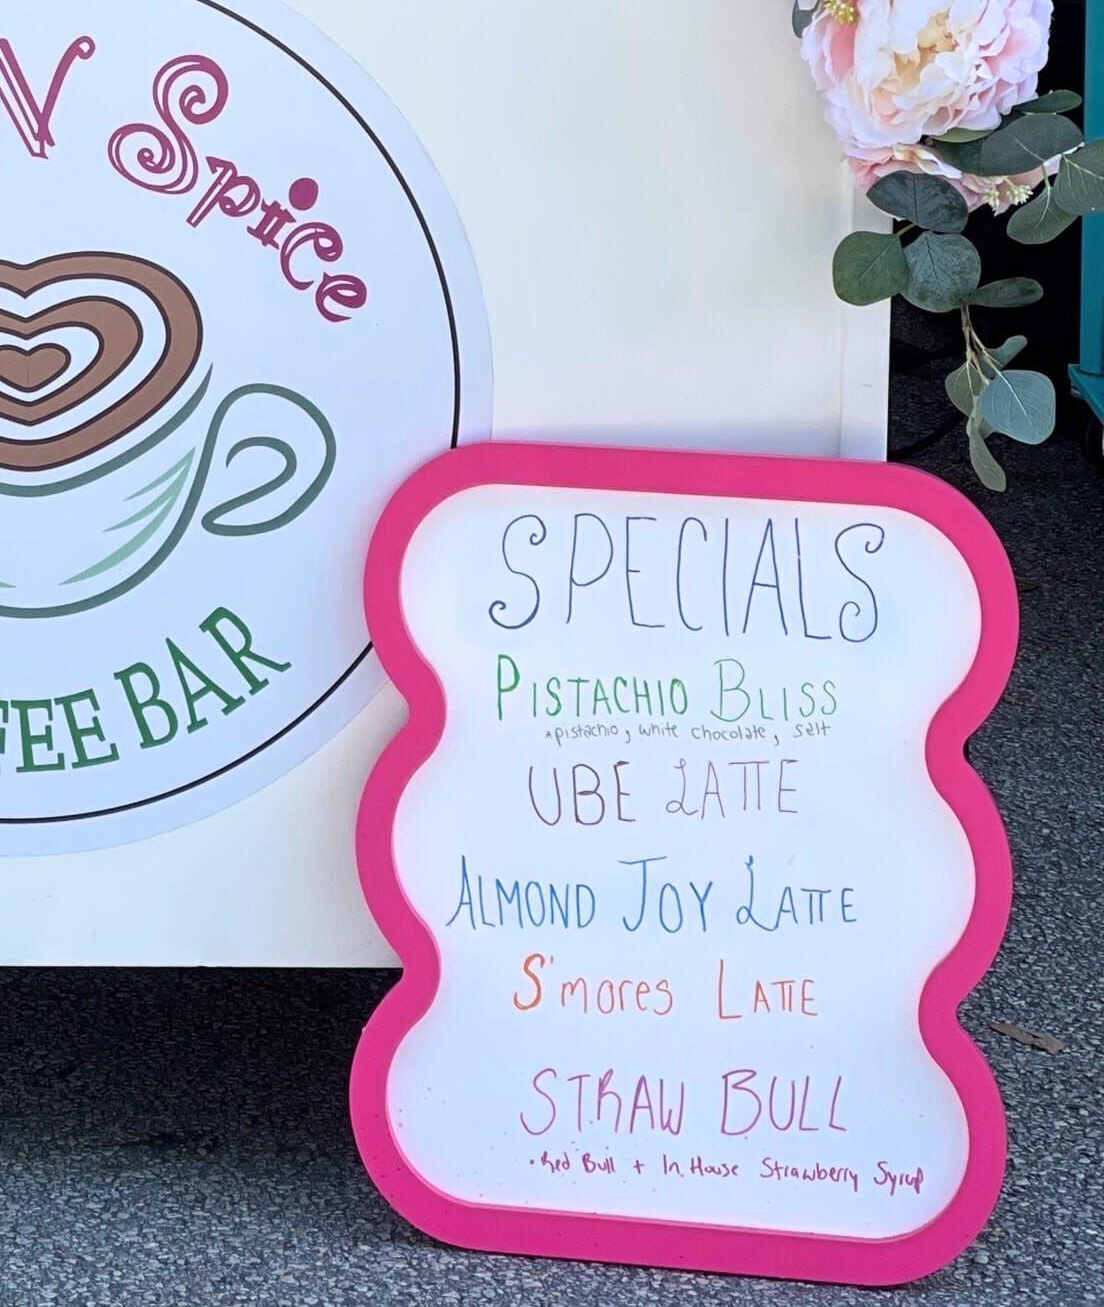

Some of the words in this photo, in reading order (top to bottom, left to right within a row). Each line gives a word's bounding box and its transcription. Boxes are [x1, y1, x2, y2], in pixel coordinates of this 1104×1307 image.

[107, 54, 368, 323] Spice
[488, 513, 885, 643] SPECIALS
[114, 606, 292, 748] BAR
[496, 654, 689, 721] PISTACHIO
[710, 658, 838, 722] BLISS
[639, 721, 679, 739] white
[793, 721, 832, 738] salt
[528, 760, 637, 826] UBE
[665, 758, 799, 820] LATTE
[445, 854, 596, 930] ALMOND
[618, 855, 714, 933] JOY
[735, 854, 858, 932] LATTE
[513, 952, 674, 1016] S'mores
[717, 959, 819, 1020] LATTE
[519, 1067, 685, 1136] STRAW
[720, 1068, 848, 1136] BULL
[541, 1151, 571, 1174] Red
[581, 1153, 616, 1174] Bull
[690, 1156, 739, 1178] House
[759, 1157, 859, 1192] Strawberry
[873, 1161, 925, 1196] Syrup
